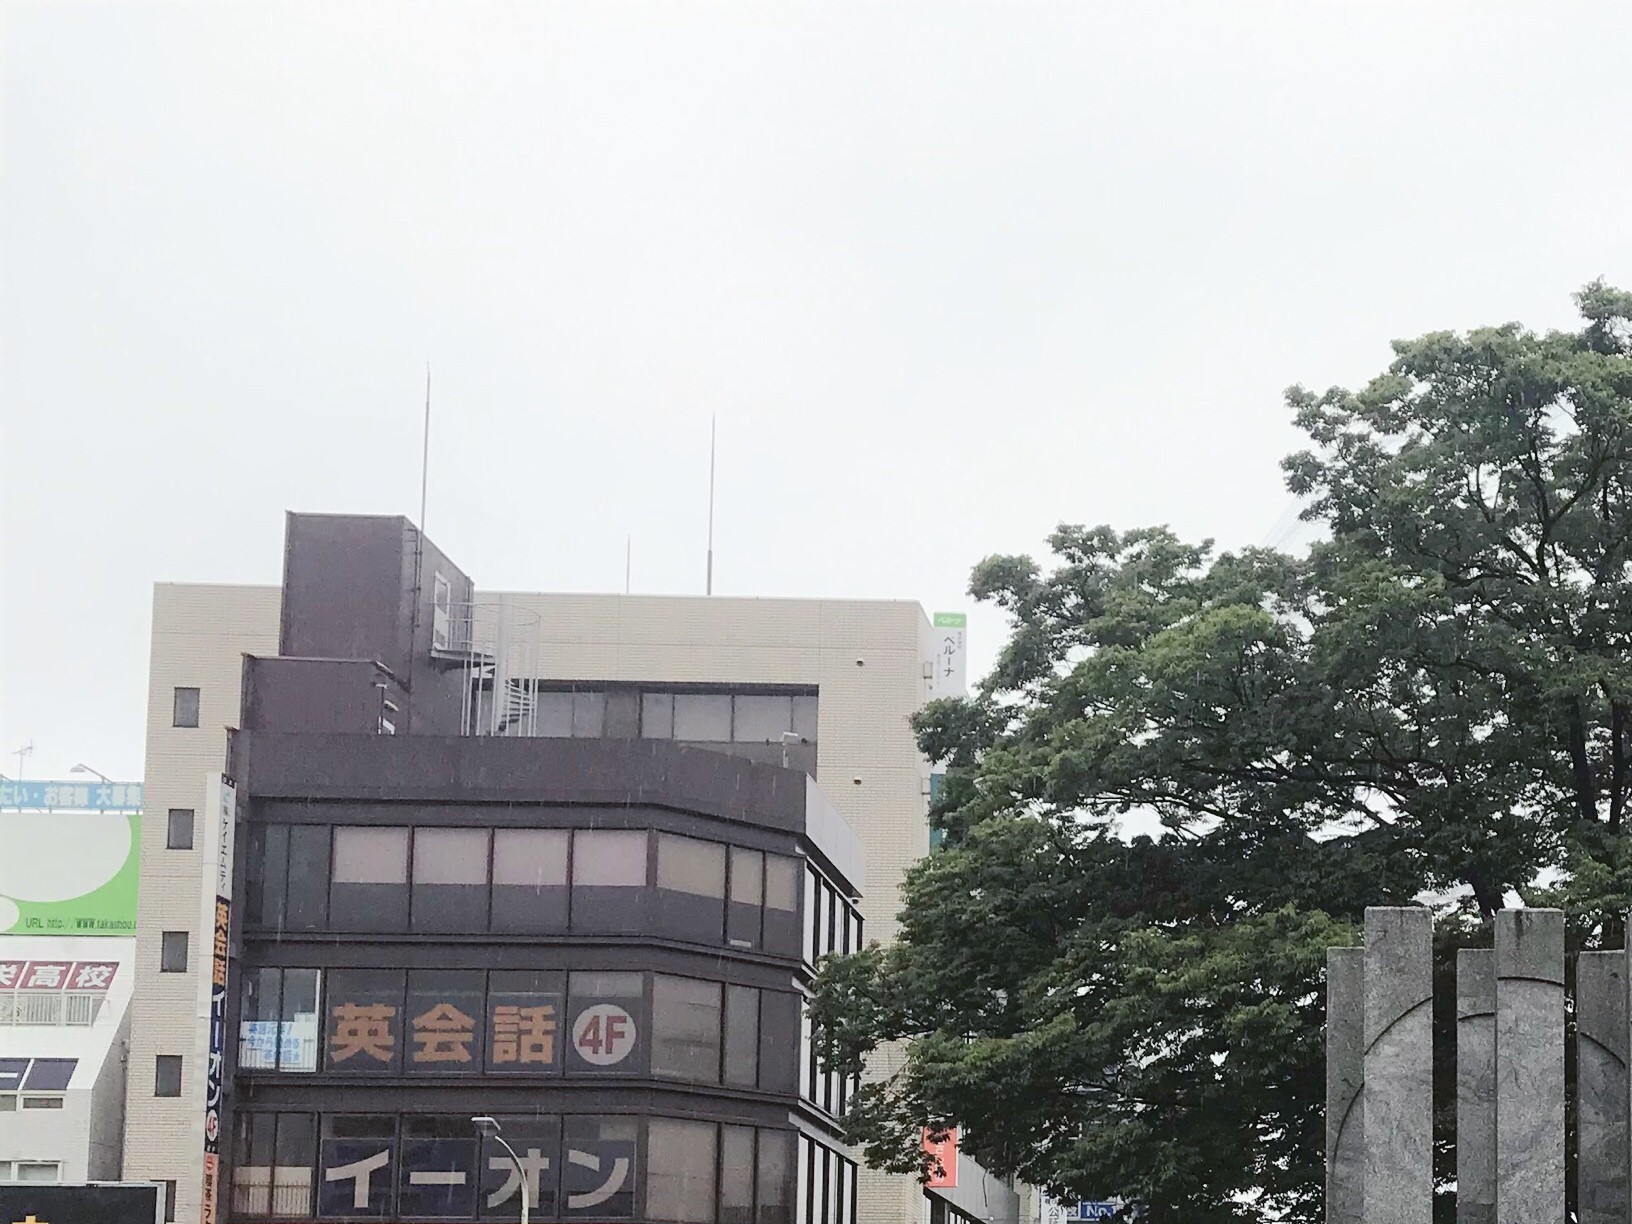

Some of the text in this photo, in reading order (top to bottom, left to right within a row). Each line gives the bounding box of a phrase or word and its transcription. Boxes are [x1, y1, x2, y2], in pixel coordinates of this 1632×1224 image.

[331, 1003, 555, 1064] 英会話
[578, 1015, 628, 1056] 4F
[326, 1147, 630, 1209] イーオン
